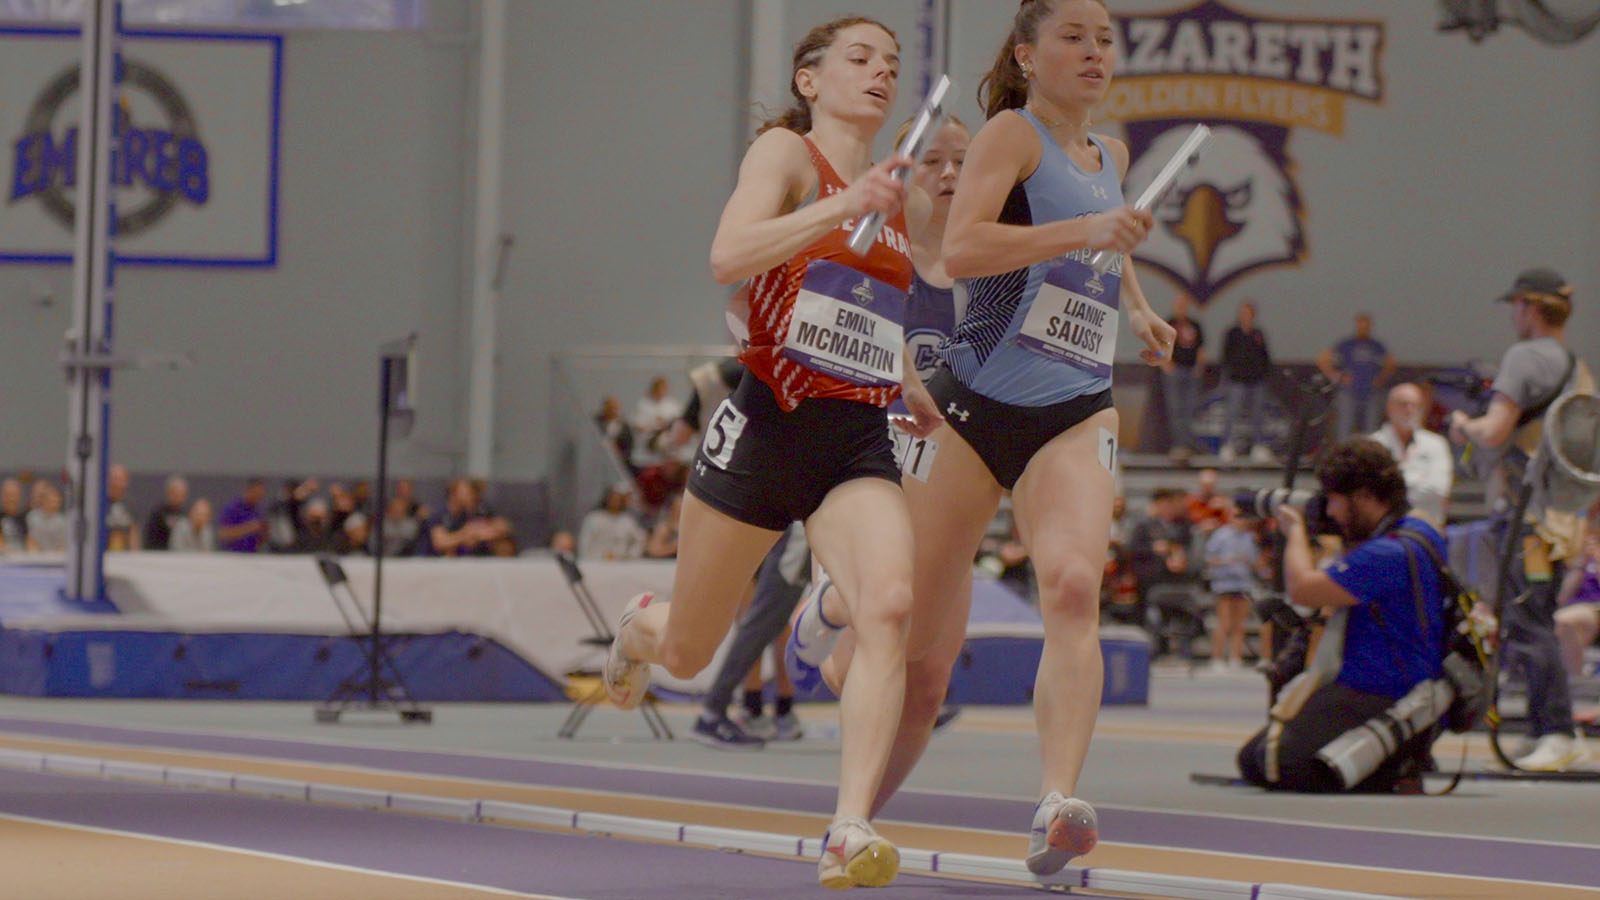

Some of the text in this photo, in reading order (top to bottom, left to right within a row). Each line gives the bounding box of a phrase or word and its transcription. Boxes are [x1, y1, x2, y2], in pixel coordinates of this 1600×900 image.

[1112, 17, 1378, 97] AZARETH
[1103, 80, 1330, 127] OLDEN FLYERS
[835, 308, 876, 337] EMILY
[1063, 298, 1107, 328] LIANNE
[796, 320, 895, 374] MCMARTIN
[1046, 315, 1104, 355] SAUSSY
[706, 404, 737, 458] 5
[911, 439, 927, 475] 1
